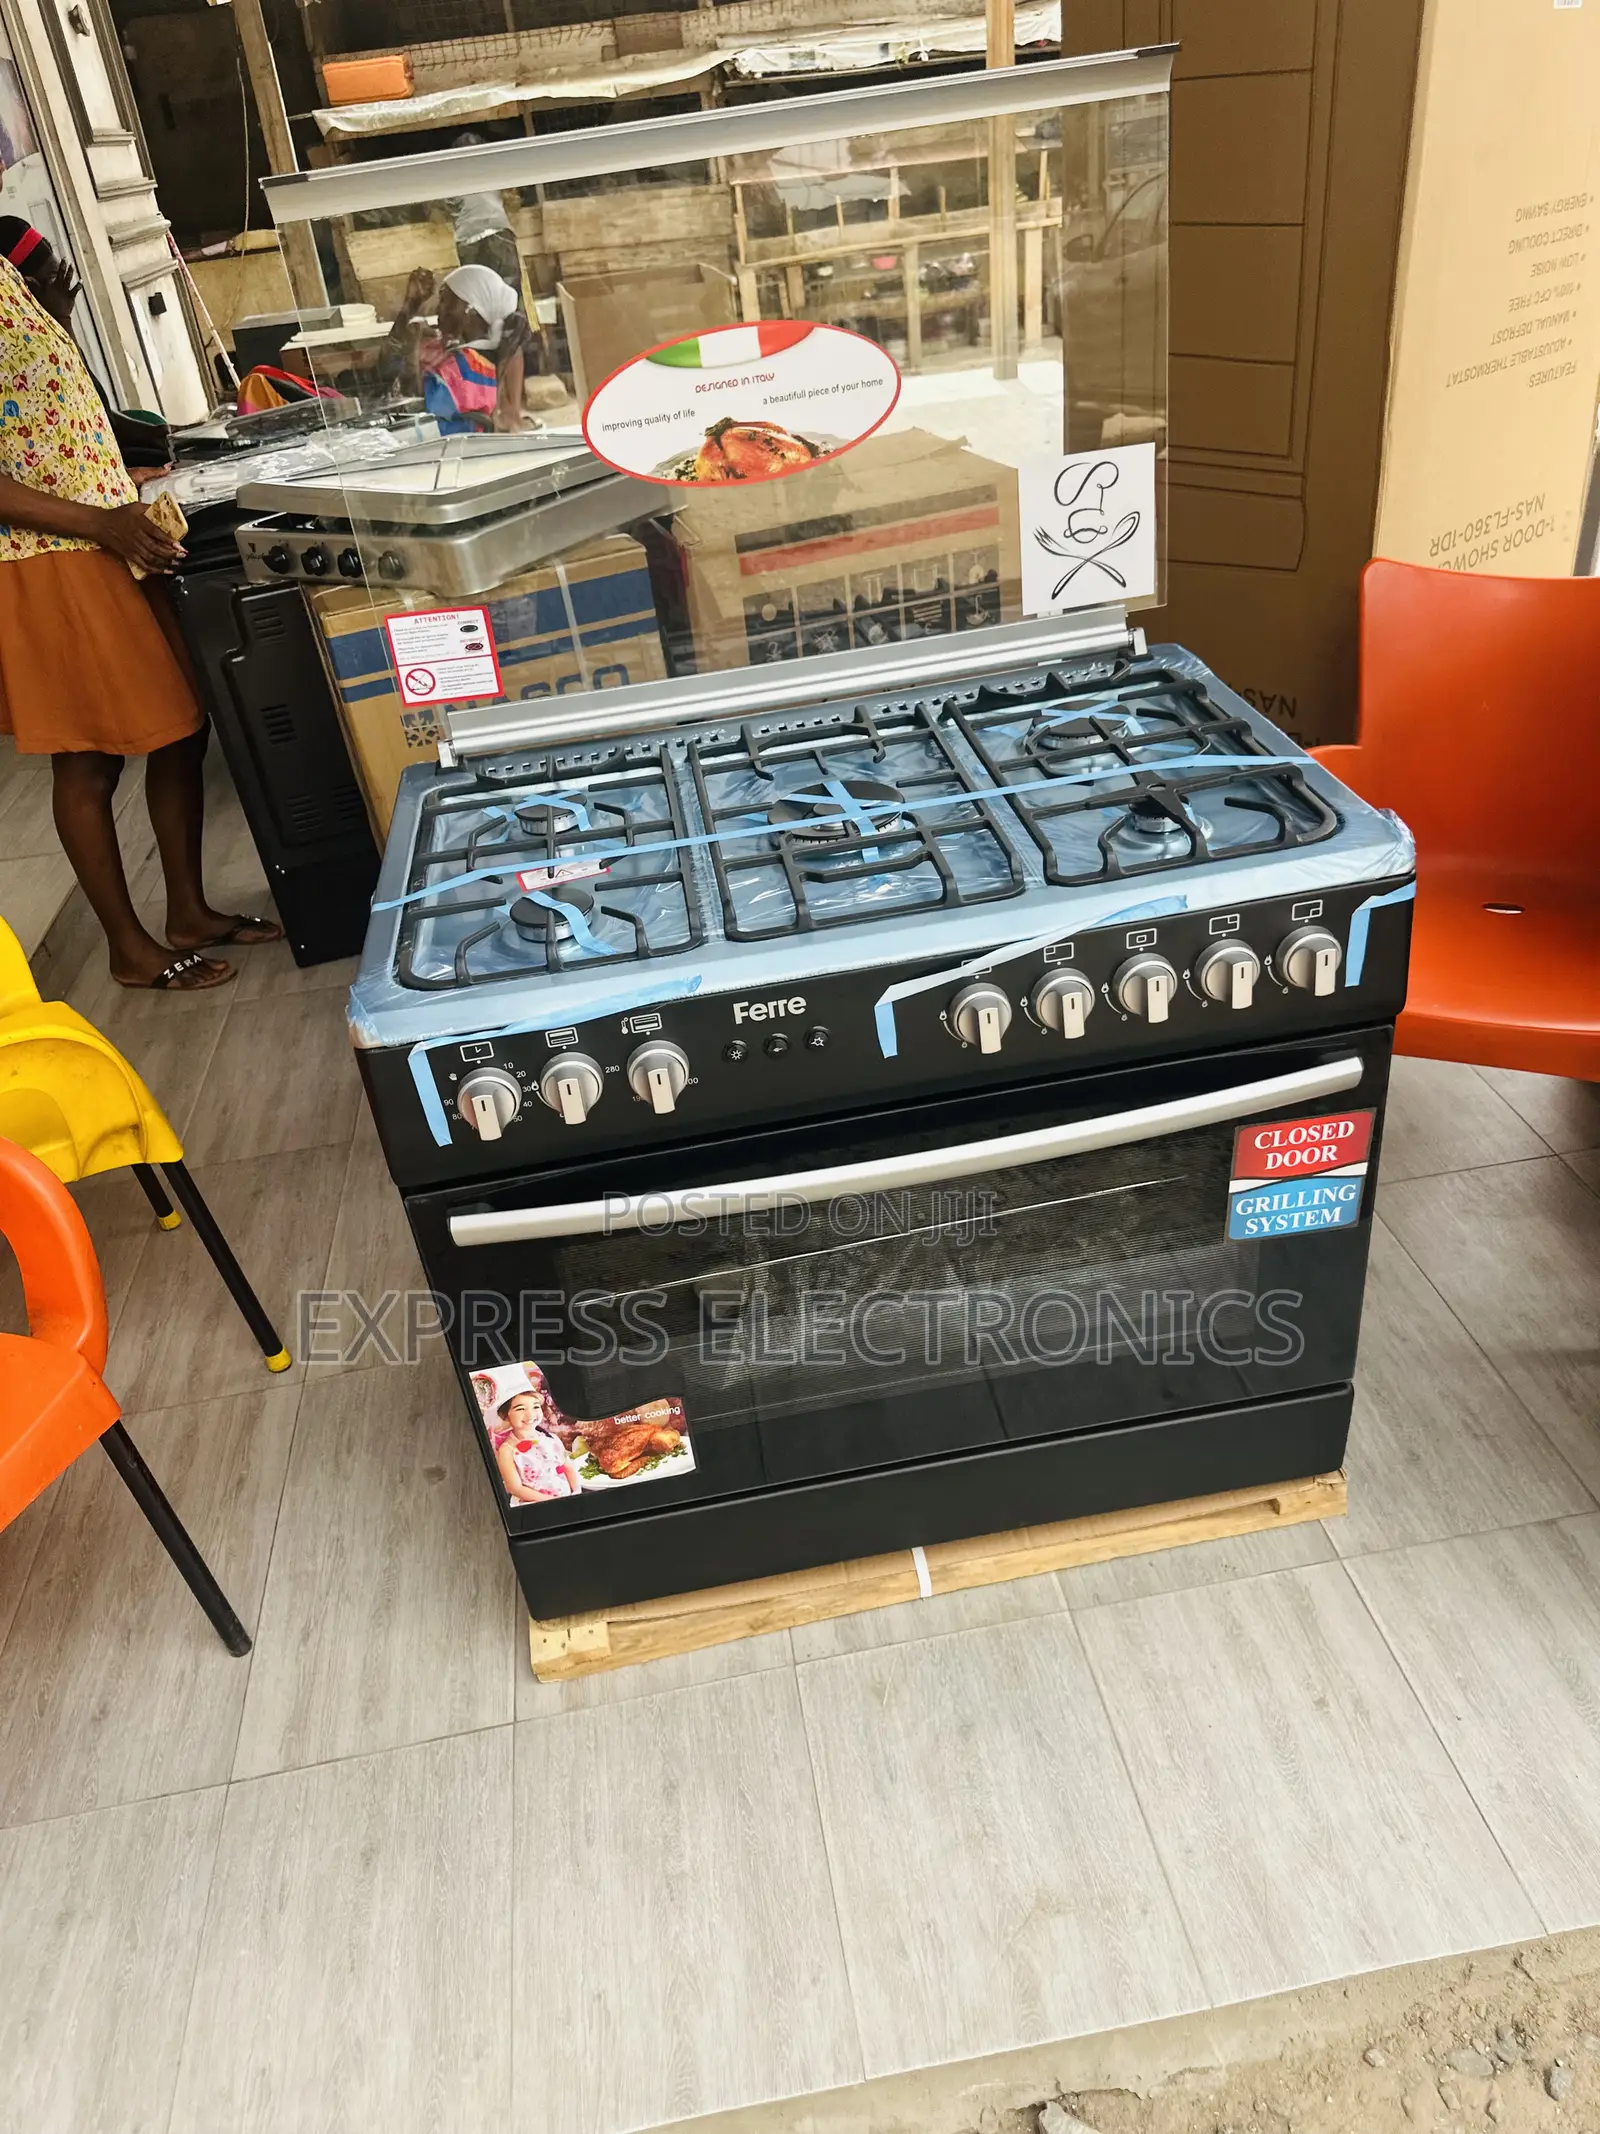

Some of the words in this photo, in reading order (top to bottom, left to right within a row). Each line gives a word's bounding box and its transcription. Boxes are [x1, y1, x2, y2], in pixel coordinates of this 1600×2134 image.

[1508, 231, 1550, 254] COOLING
[1551, 223, 1583, 243] DIRECT
[1508, 294, 1533, 312] FREE
[1536, 310, 1570, 331] MANUAL
[1490, 321, 1533, 346] DEFROST
[1510, 336, 1567, 368] ADJUSTABLE
[695, 378, 739, 393] DESIGNED
[741, 376, 750, 385] IN
[1446, 358, 1509, 388] THERMOSTAT
[1528, 360, 1577, 388] FEATURES
[770, 388, 806, 404] beautifull
[808, 386, 828, 398] piece
[831, 382, 840, 394] of
[842, 382, 860, 396] your
[862, 377, 883, 390] home
[602, 416, 643, 432] improving
[644, 411, 671, 427] quality
[673, 411, 681, 420] of
[683, 407, 696, 419] life
[1429, 492, 1546, 557] NAS-FL360-1DR
[1503, 516, 1555, 553] 1-DOOR
[414, 613, 460, 625] ATTENTION!
[163, 954, 202, 979] ZERA
[732, 995, 807, 1025] Ferre
[503, 1062, 514, 1070] 10
[516, 1070, 527, 1078] 20
[605, 1065, 620, 1074] 280
[443, 1098, 454, 1106] 90
[1254, 1120, 1355, 1150] CLOSED
[1264, 1144, 1338, 1170] DOOR
[1235, 1184, 1357, 1216] GRILLING
[1244, 1206, 1343, 1235] SYSTEM
[614, 1413, 641, 1425] better
[645, 1405, 681, 1420] cooking
